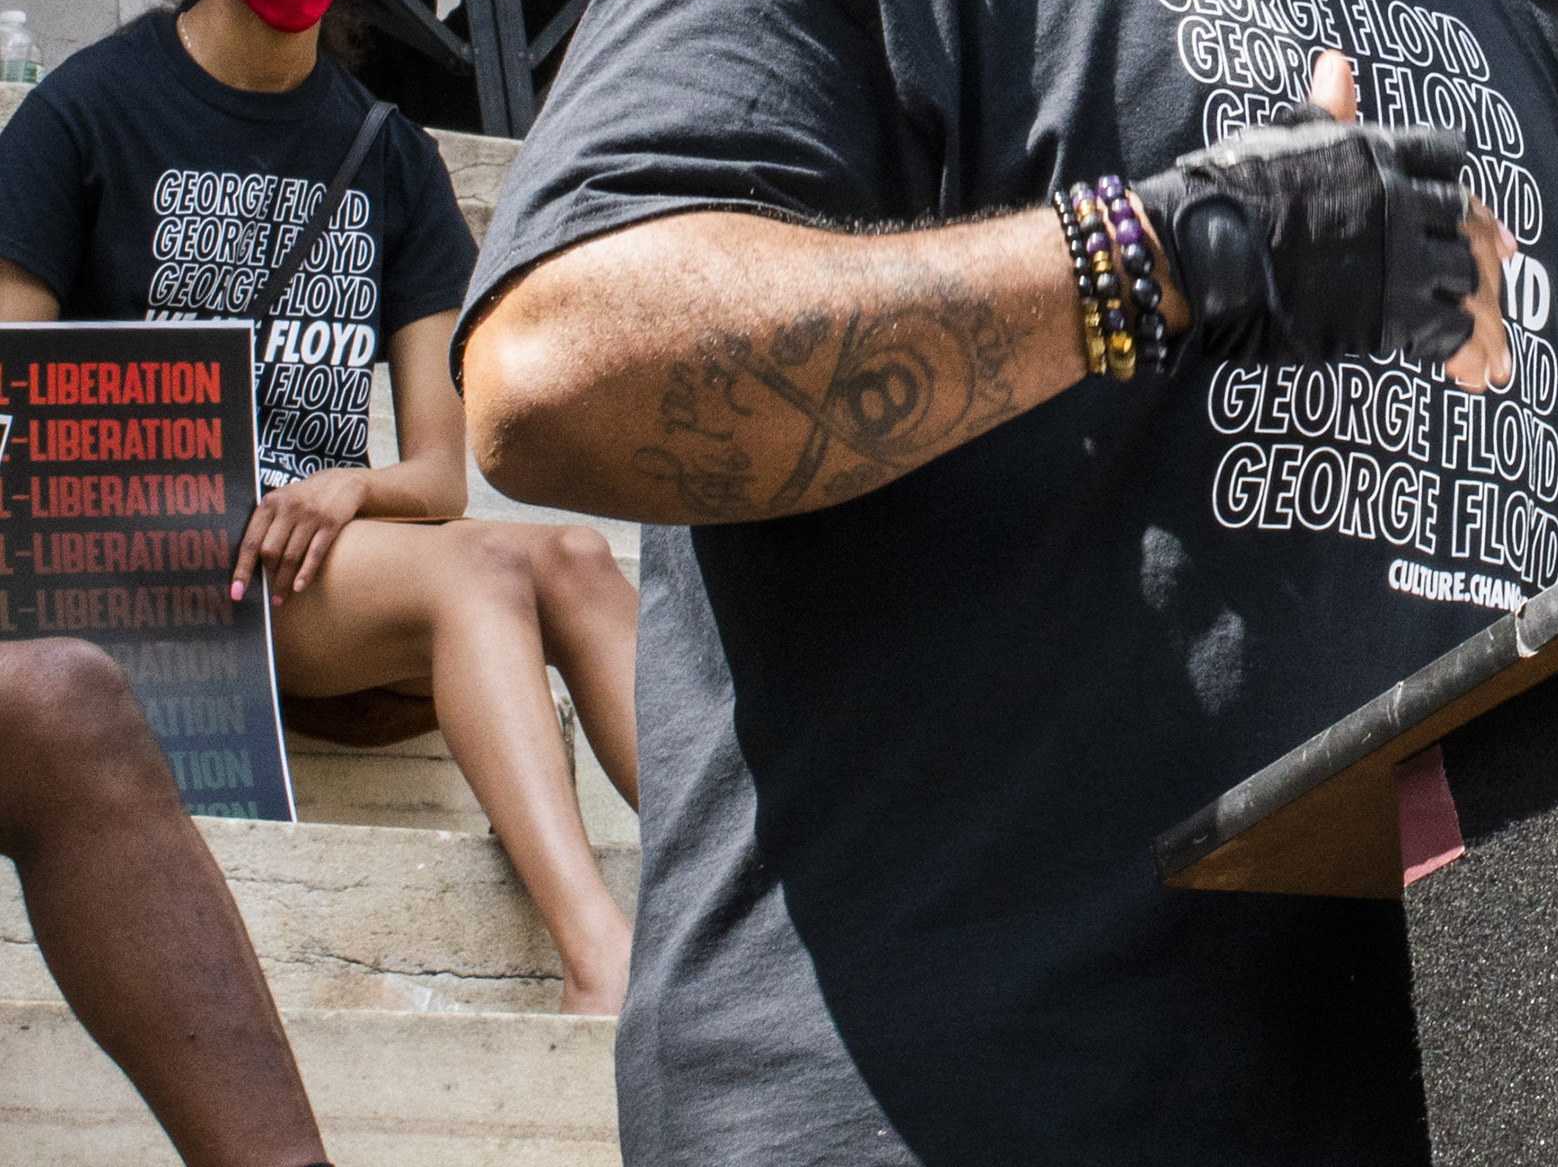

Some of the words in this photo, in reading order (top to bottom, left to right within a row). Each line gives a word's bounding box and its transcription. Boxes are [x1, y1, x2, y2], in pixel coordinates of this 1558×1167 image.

[1373, 63, 1524, 160] FLOYD
[153, 169, 278, 220] GEORGE
[152, 216, 271, 267] GEORGE
[264, 320, 376, 367] FLOYD
[265, 363, 373, 412] FLOYD
[1208, 360, 1430, 462] GEORGE
[262, 409, 369, 457] FLOYD
[1212, 442, 1440, 555] GEORGE
